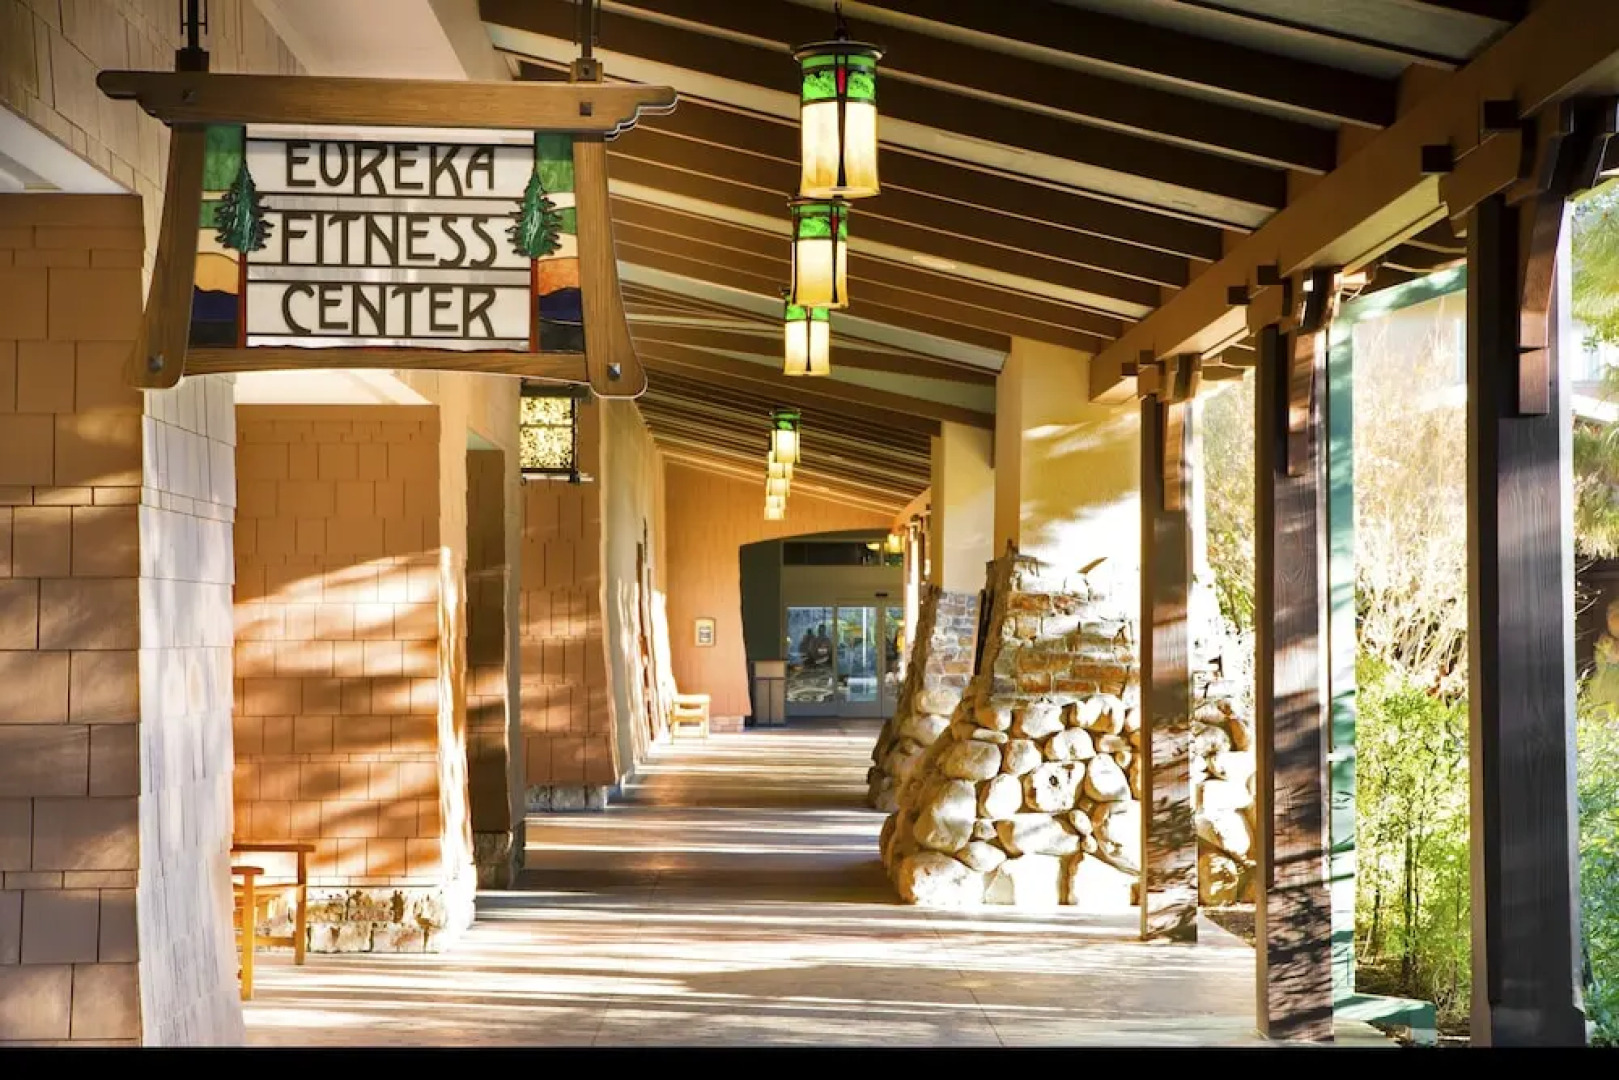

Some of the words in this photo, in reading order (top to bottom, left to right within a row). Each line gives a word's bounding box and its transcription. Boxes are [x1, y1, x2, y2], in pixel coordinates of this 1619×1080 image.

[286, 142, 495, 196] EUREKA
[281, 212, 498, 267] FITNESS
[281, 283, 497, 338] CENTER
